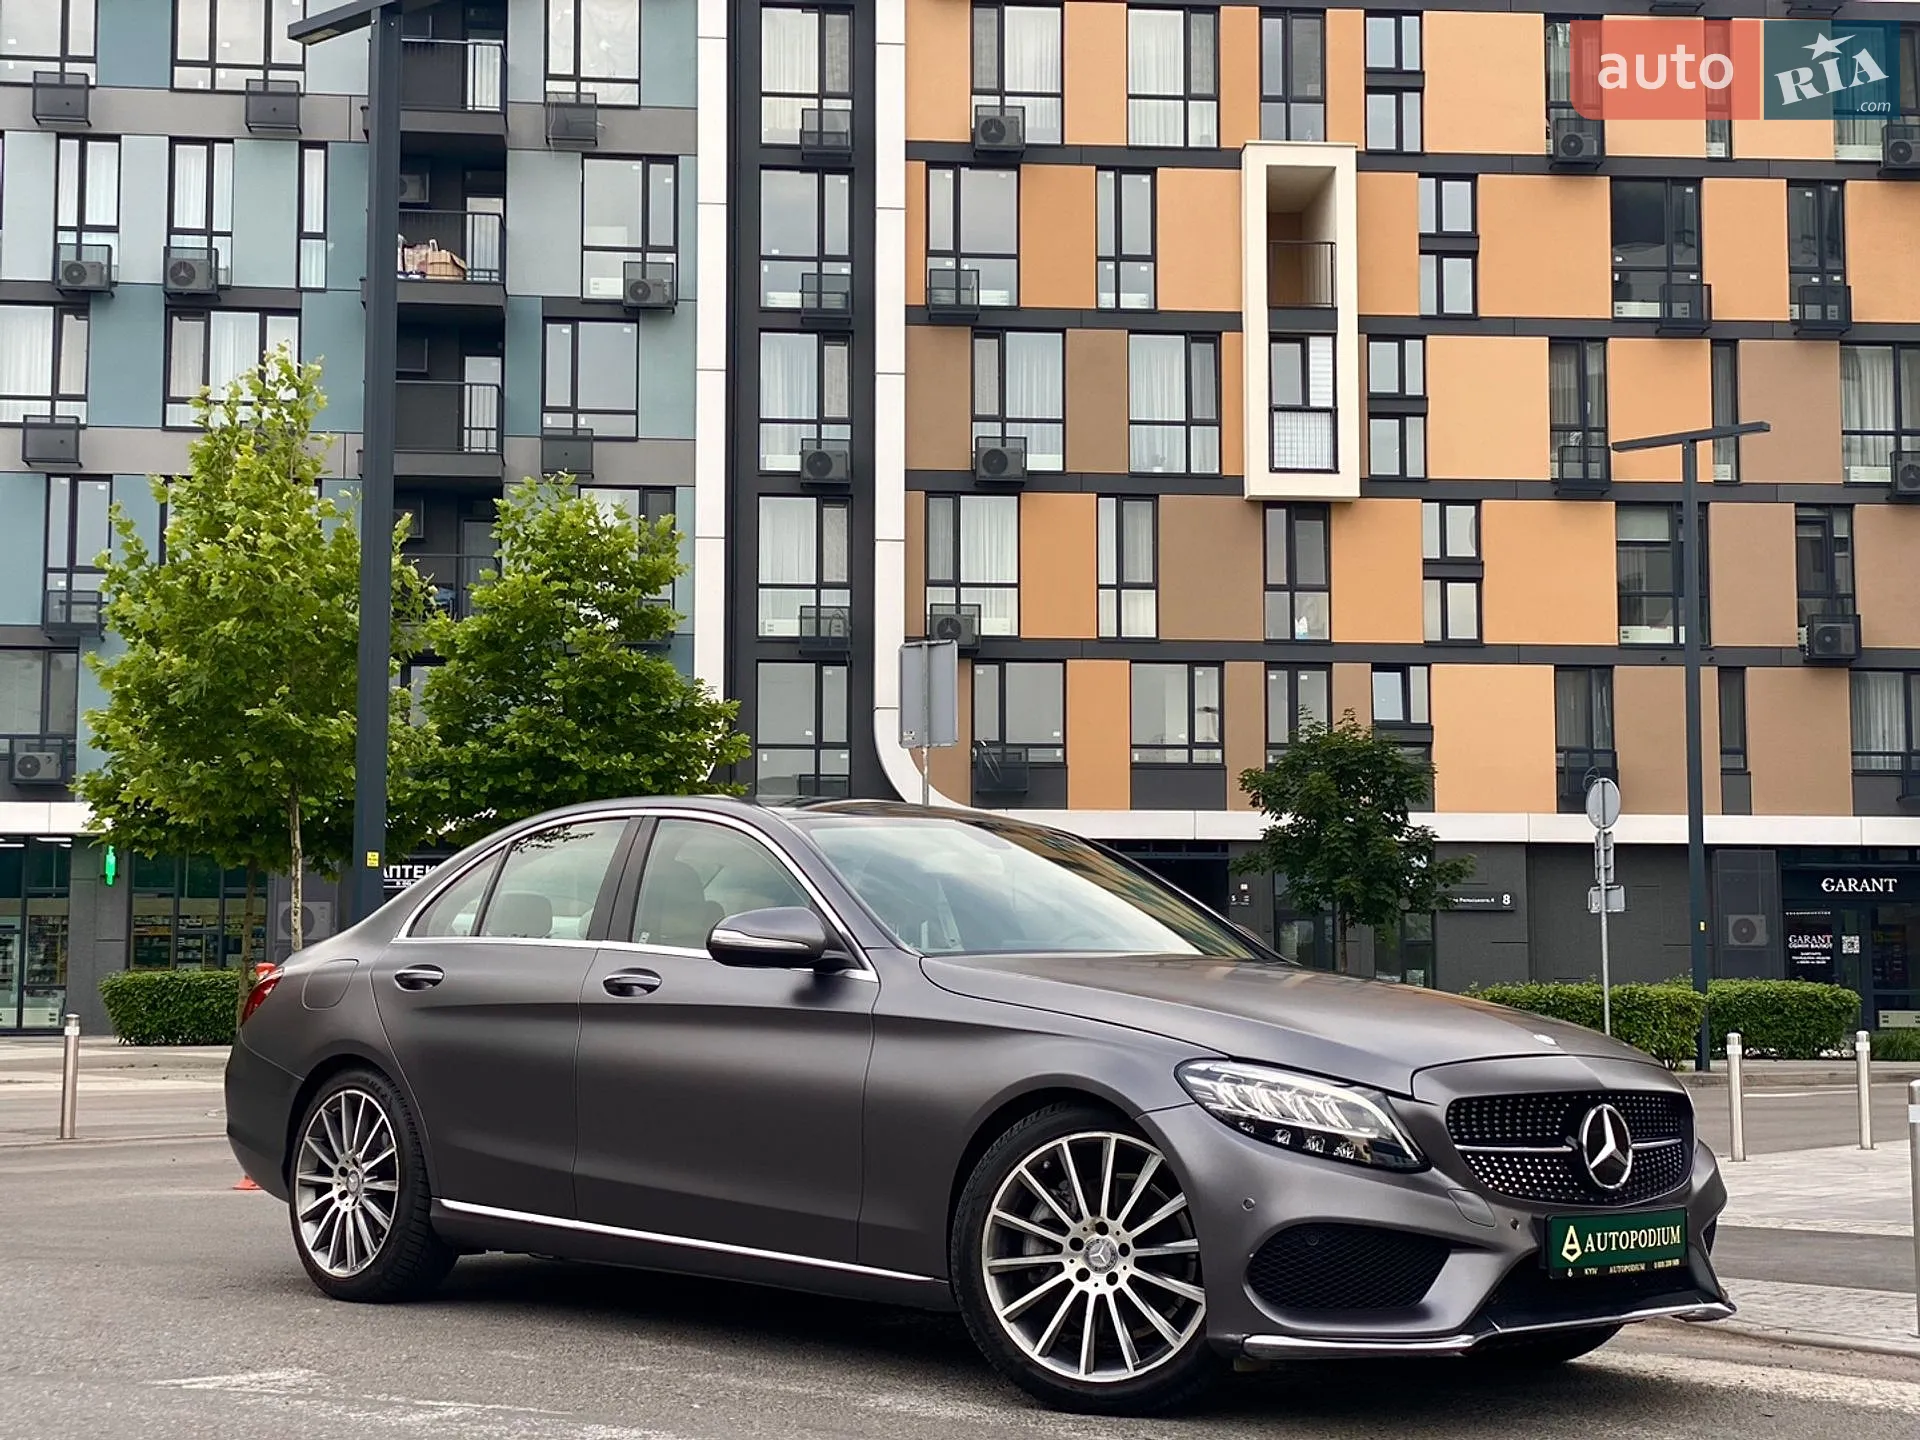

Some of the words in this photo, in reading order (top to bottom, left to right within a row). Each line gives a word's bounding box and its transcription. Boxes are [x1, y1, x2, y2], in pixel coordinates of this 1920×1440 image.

[1821, 877, 1898, 893] GARANT
[1502, 894, 1511, 905] 8
[1788, 934, 1833, 944] GARANT
[1584, 1225, 1680, 1252] AUTOPODIUM
